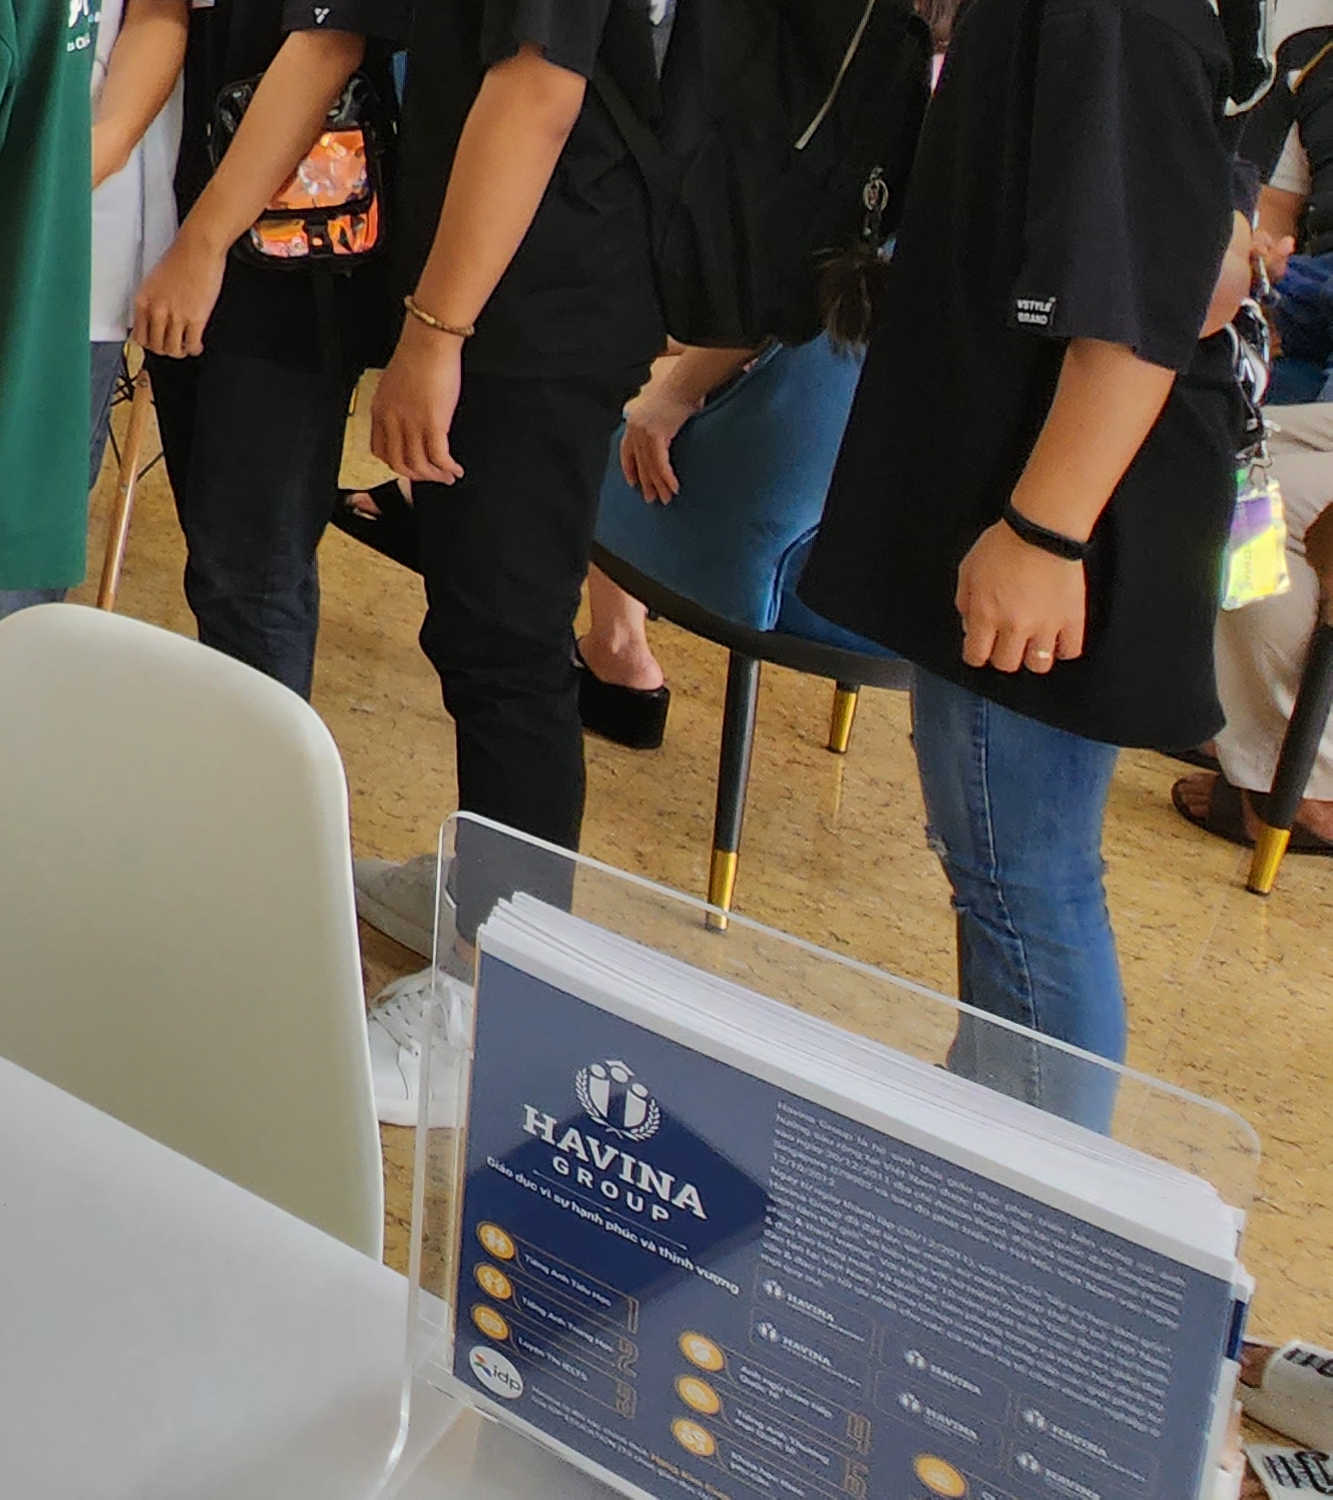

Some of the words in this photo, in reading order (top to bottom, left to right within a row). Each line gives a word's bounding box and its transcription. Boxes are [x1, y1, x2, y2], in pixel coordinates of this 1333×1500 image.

[523, 1103, 707, 1220] HAVINA
[552, 1156, 670, 1222] GROUP
[487, 1155, 514, 1179] Giáo
[515, 1170, 538, 1192] dục
[540, 1184, 552, 1199] vì
[554, 1192, 570, 1209] sự
[571, 1200, 604, 1226] hạnh
[605, 1218, 639, 1244] phúc
[640, 1235, 658, 1254] và
[658, 1244, 695, 1271] thịnh
[695, 1265, 741, 1296] vượng
[493, 1365, 521, 1392] idp
